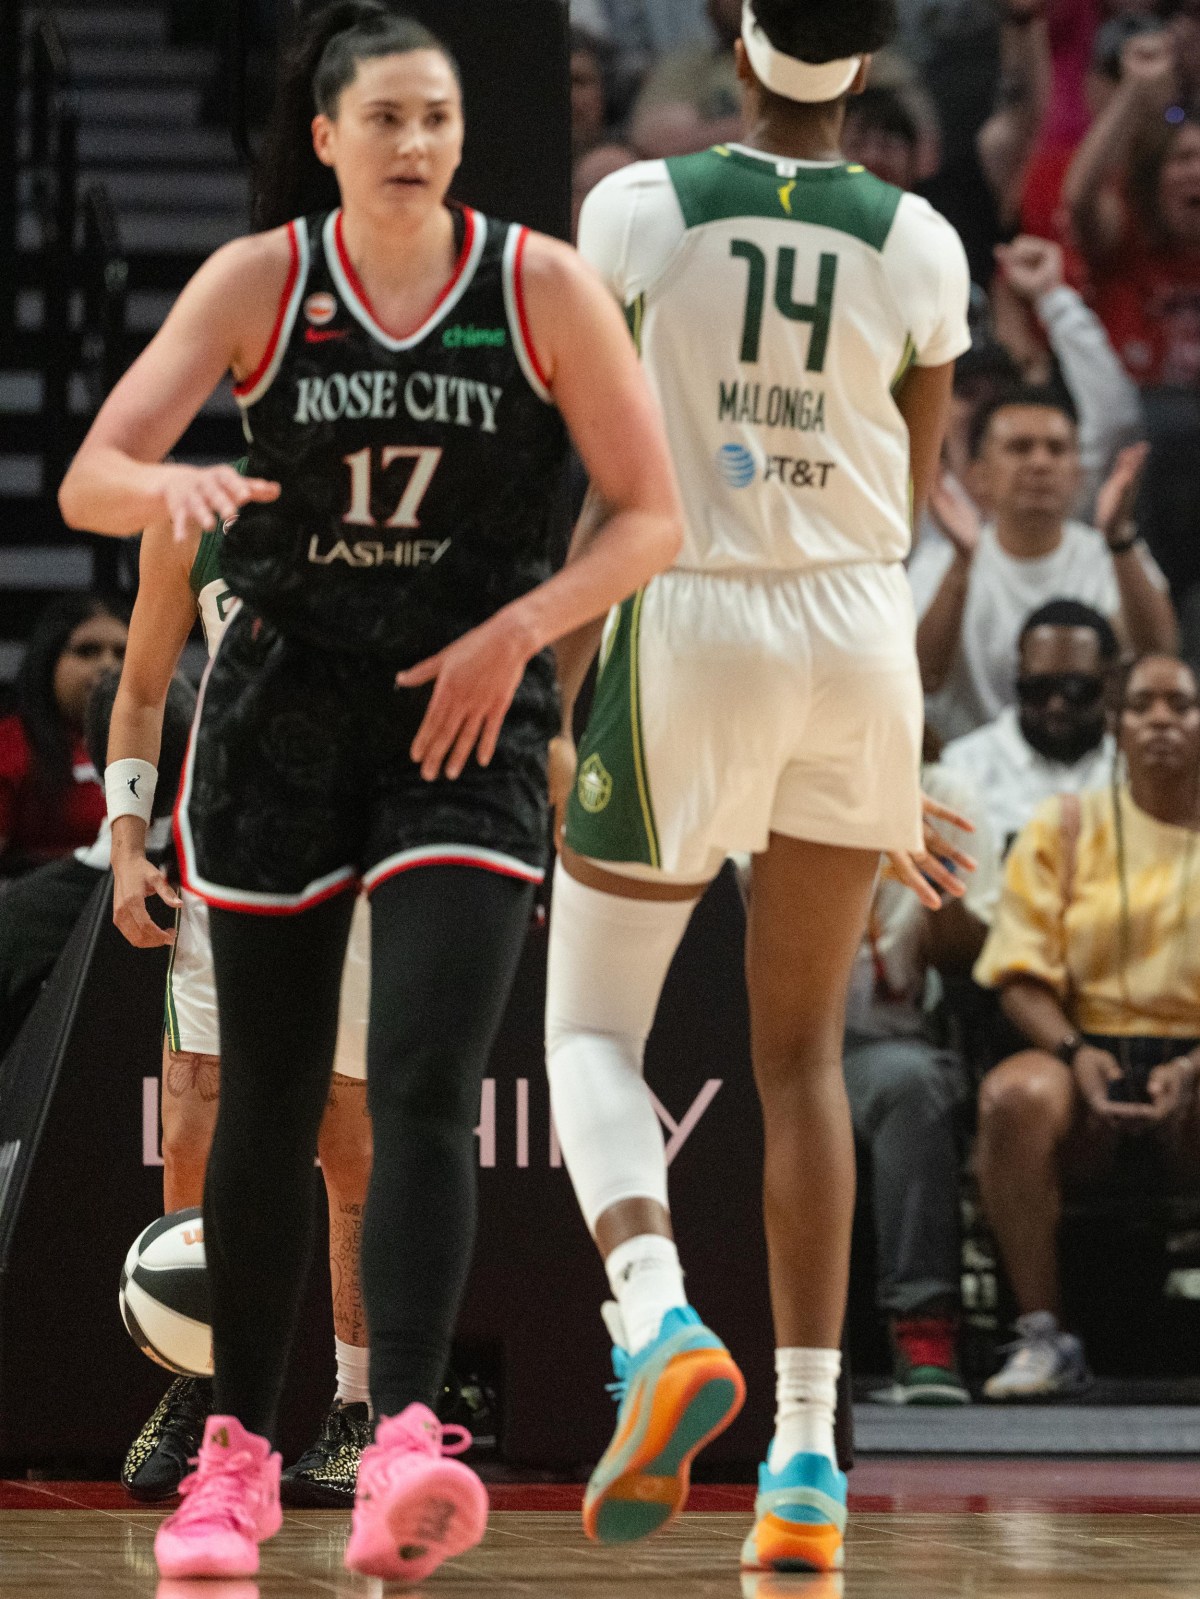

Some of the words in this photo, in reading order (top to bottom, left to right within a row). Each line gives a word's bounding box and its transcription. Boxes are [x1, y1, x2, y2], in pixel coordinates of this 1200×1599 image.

[729, 238, 839, 373] 14
[294, 371, 399, 425] ROSE
[404, 372, 502, 434] CITY
[718, 380, 826, 432] MALONGA
[341, 445, 443, 528] 17
[308, 533, 452, 567] LASHIFY
